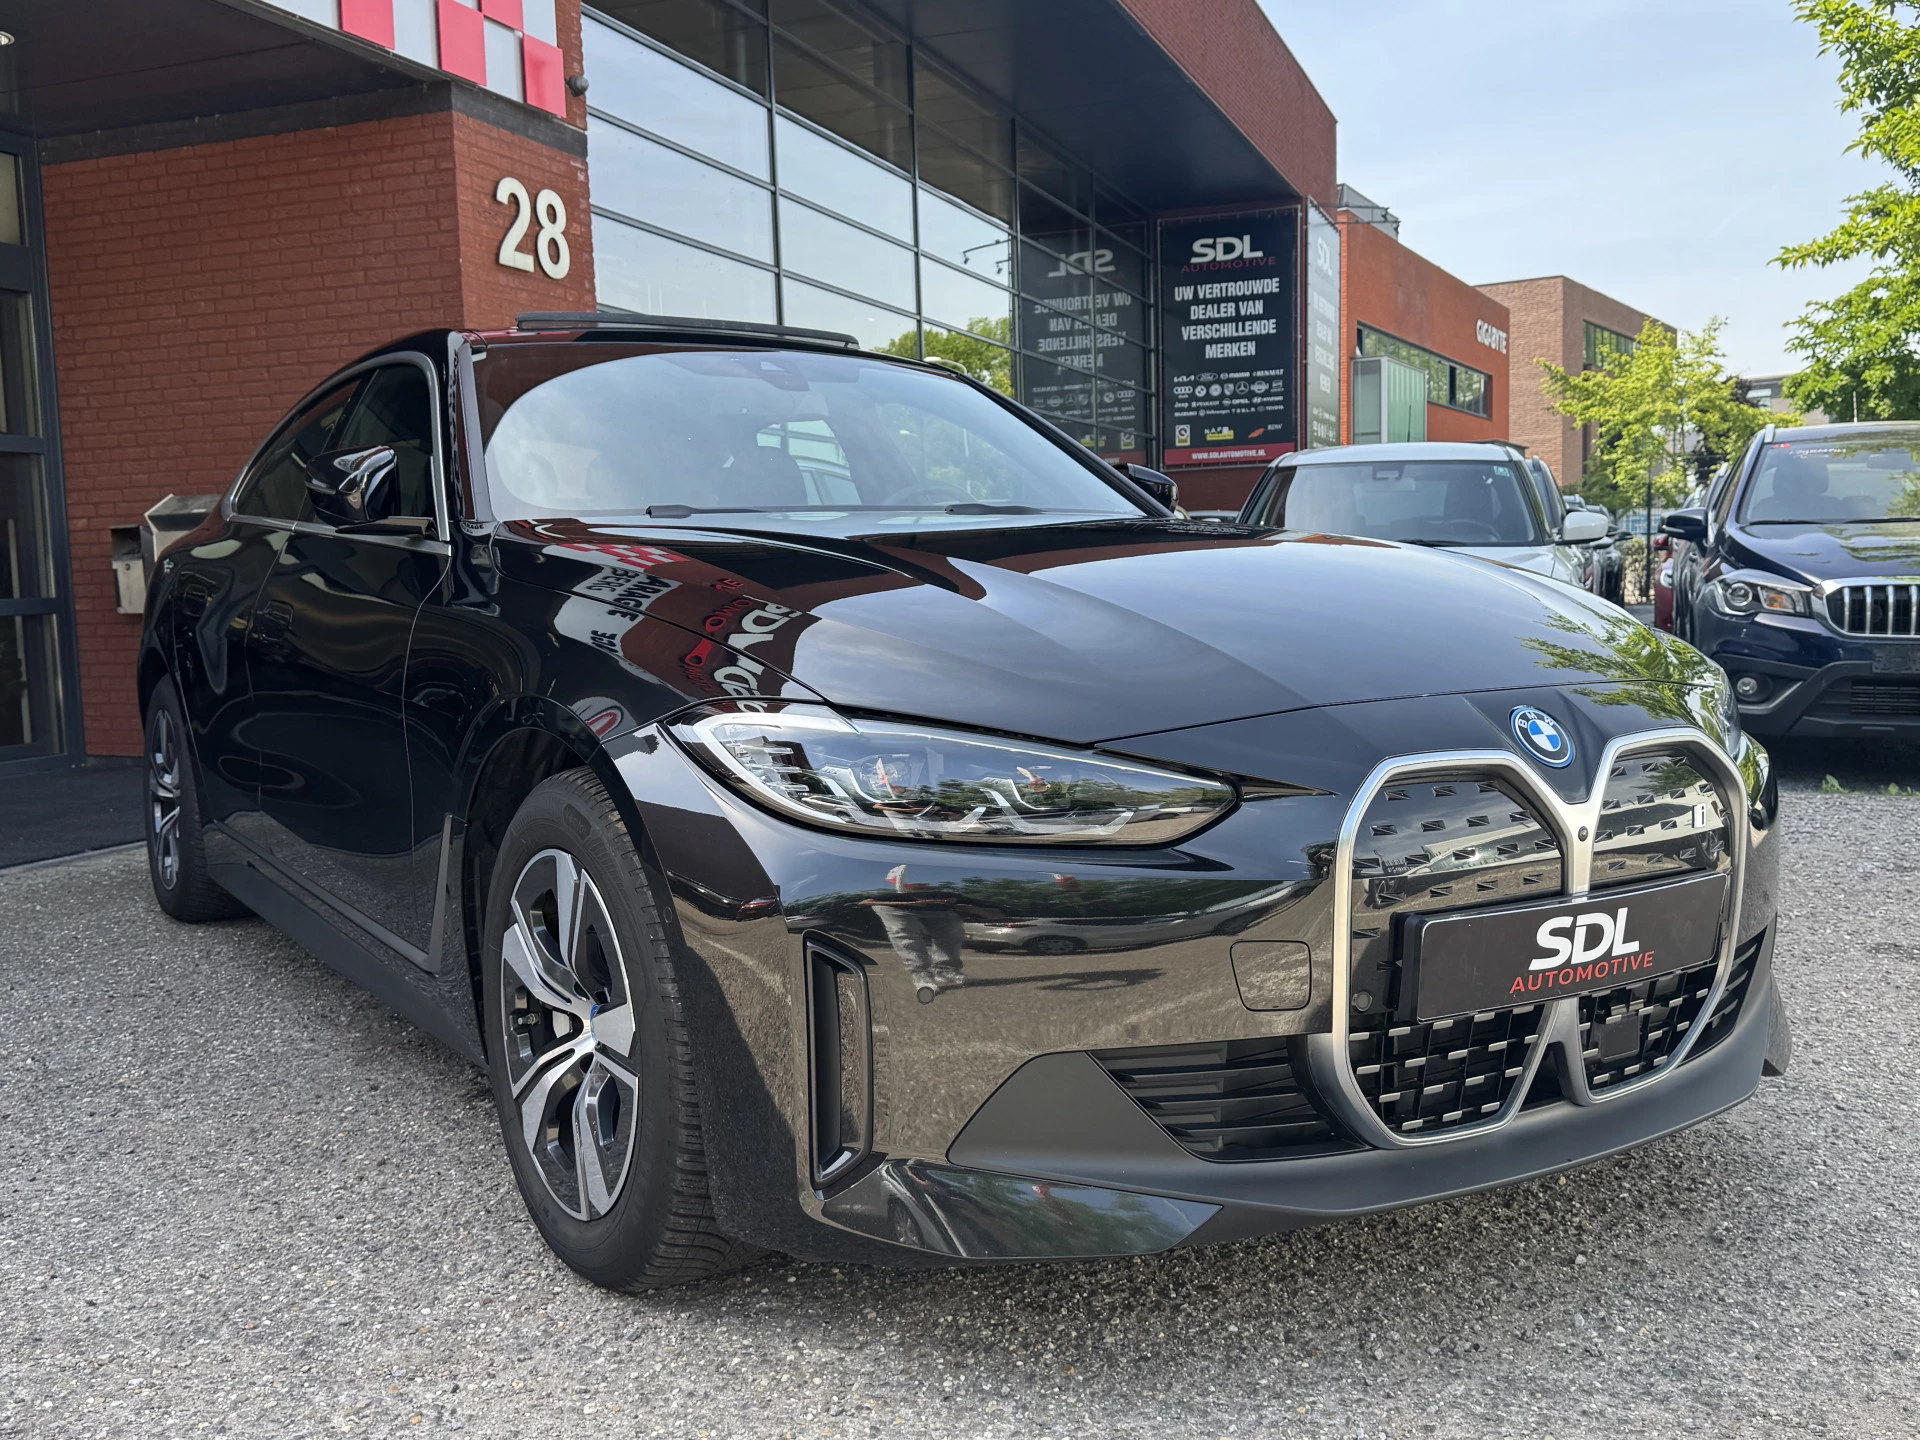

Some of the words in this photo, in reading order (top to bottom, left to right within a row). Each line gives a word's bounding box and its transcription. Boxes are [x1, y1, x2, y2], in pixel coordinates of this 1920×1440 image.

[496, 176, 571, 279] 28
[1190, 234, 1263, 263] SDL
[1181, 256, 1277, 273] AUTOMOTIVE
[1174, 285, 1194, 301] UW
[1197, 277, 1280, 299] VERTROUWDE
[1190, 302, 1236, 320] DEALER
[1239, 299, 1264, 316] VAN
[1181, 318, 1277, 341] VERSCHILLENDE
[1476, 319, 1508, 355] GIGABYTE
[1205, 340, 1256, 359] MERKEN
[1518, 711, 1555, 728] BMW
[1528, 907, 1640, 971] SDL
[1509, 950, 1655, 995] AUTOMOTIVE
